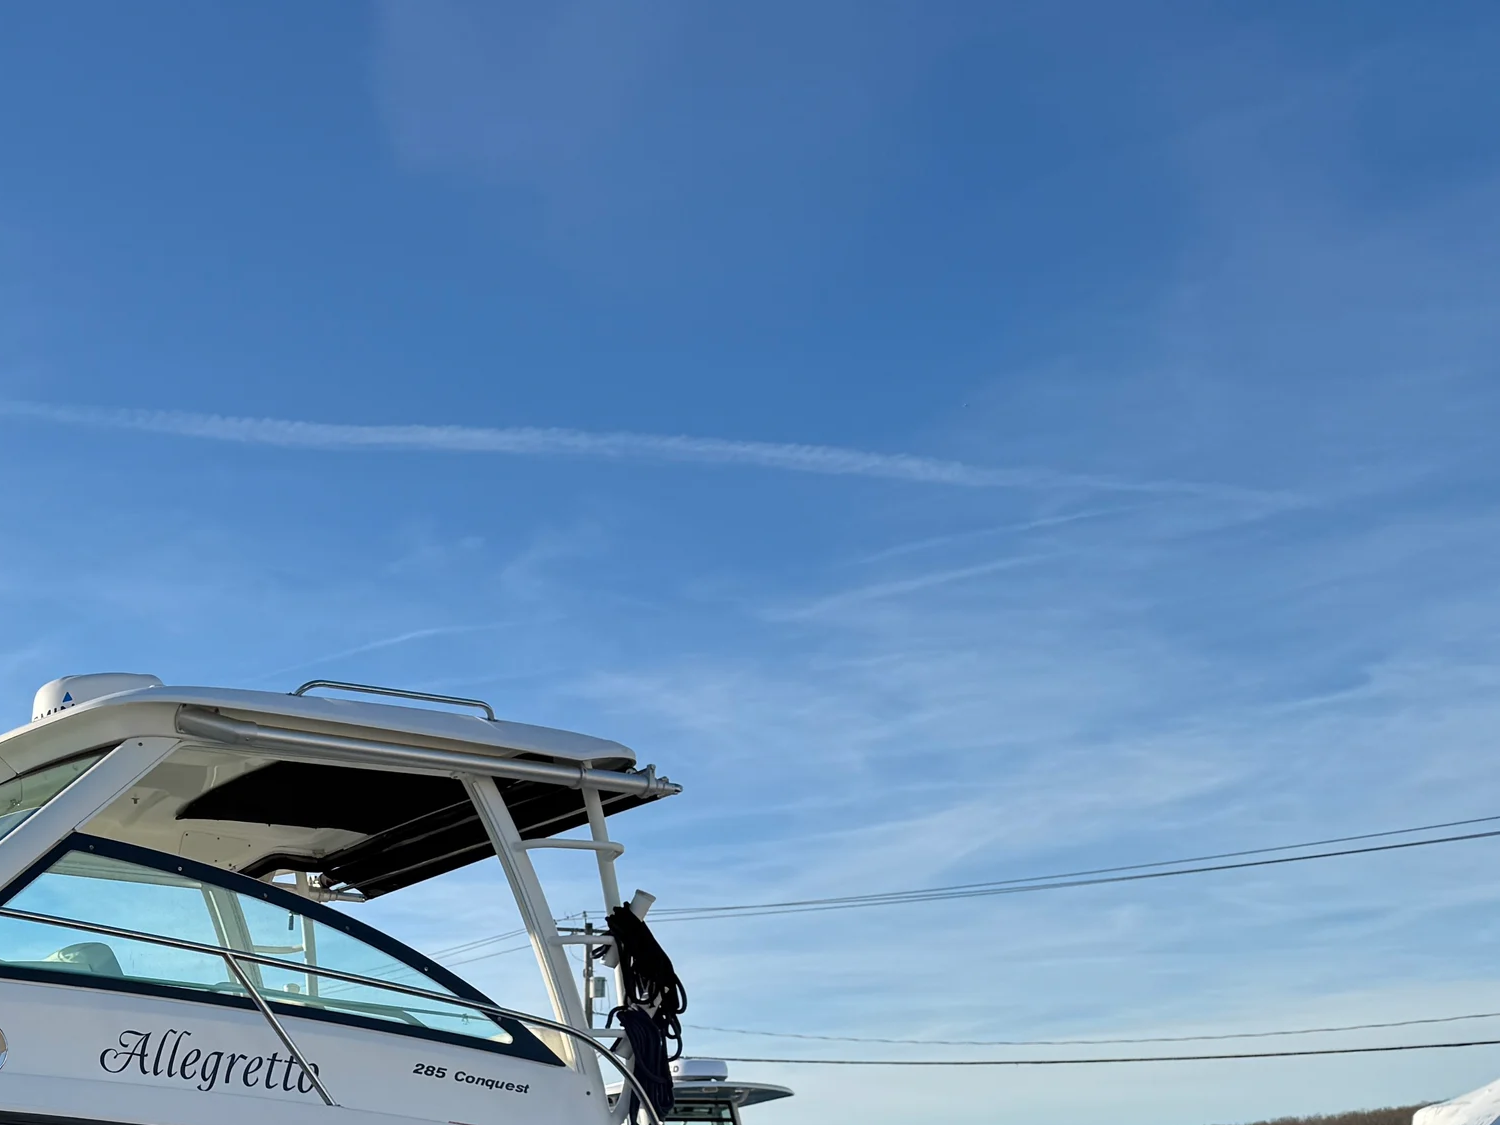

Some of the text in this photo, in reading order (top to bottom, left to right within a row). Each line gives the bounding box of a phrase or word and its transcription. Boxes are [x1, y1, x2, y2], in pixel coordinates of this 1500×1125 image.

[99, 1028, 319, 1093] Allegretto
[412, 1063, 530, 1094] 285 Conquest
